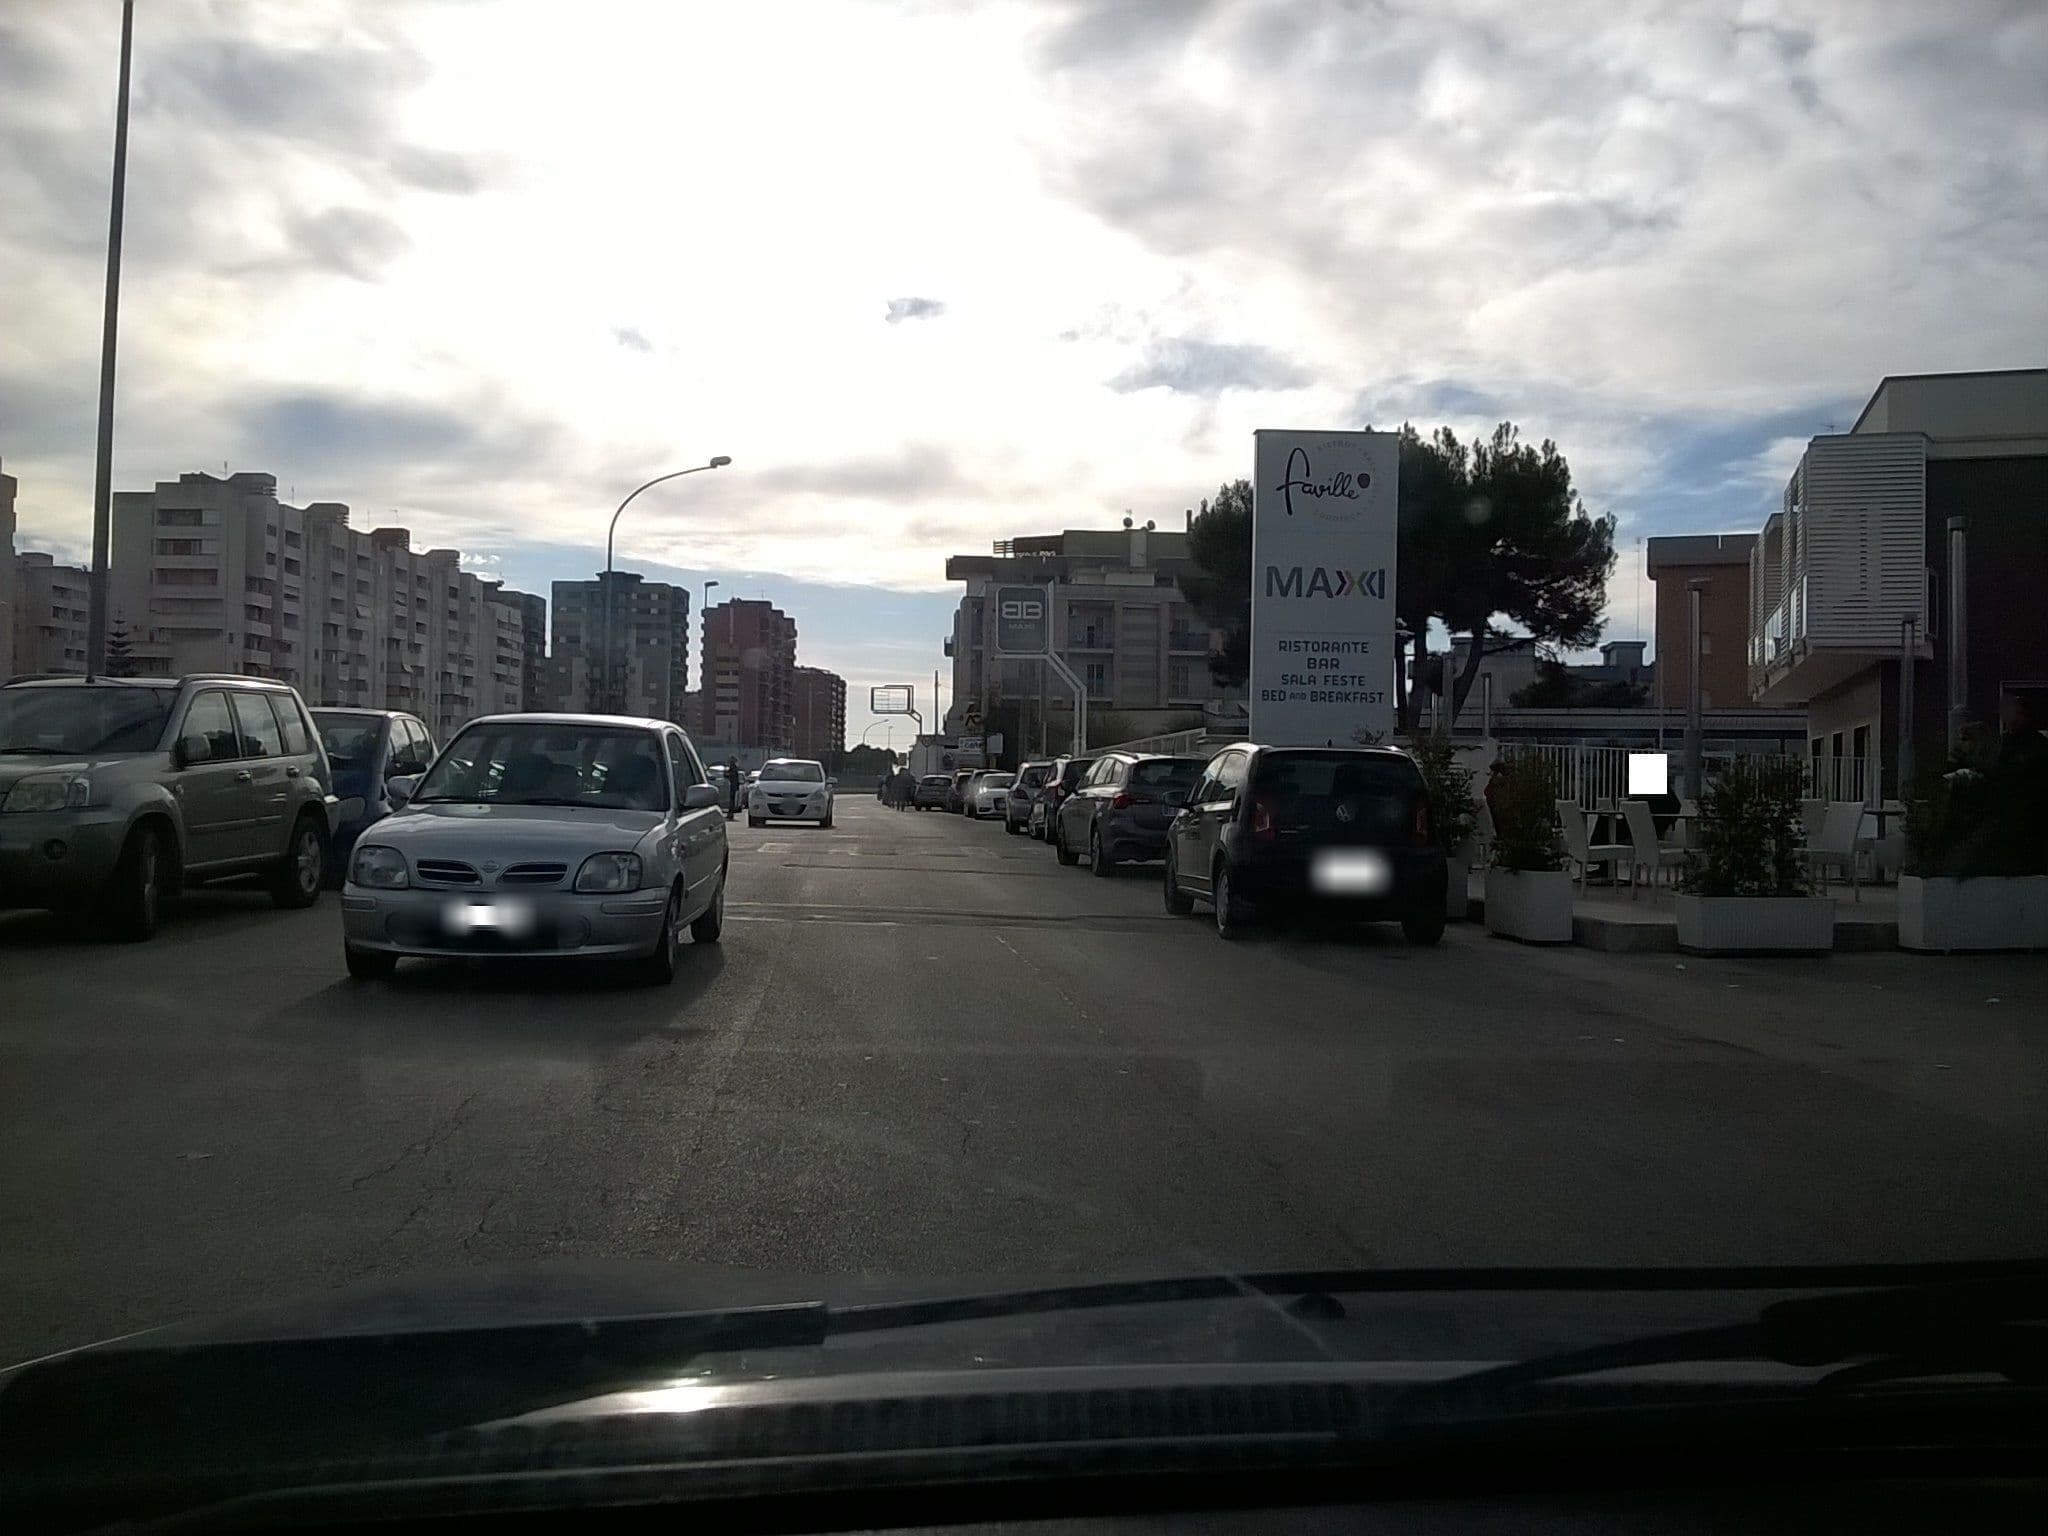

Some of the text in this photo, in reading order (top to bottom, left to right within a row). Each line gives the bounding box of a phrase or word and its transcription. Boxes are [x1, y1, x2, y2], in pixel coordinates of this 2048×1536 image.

[1278, 640, 1370, 653] RISTORANTE
[1307, 657, 1340, 669] BAR
[1281, 674, 1366, 686] SALA FESTE
[1261, 690, 1287, 702] BED
[1310, 690, 1385, 703] BREAKFAST
